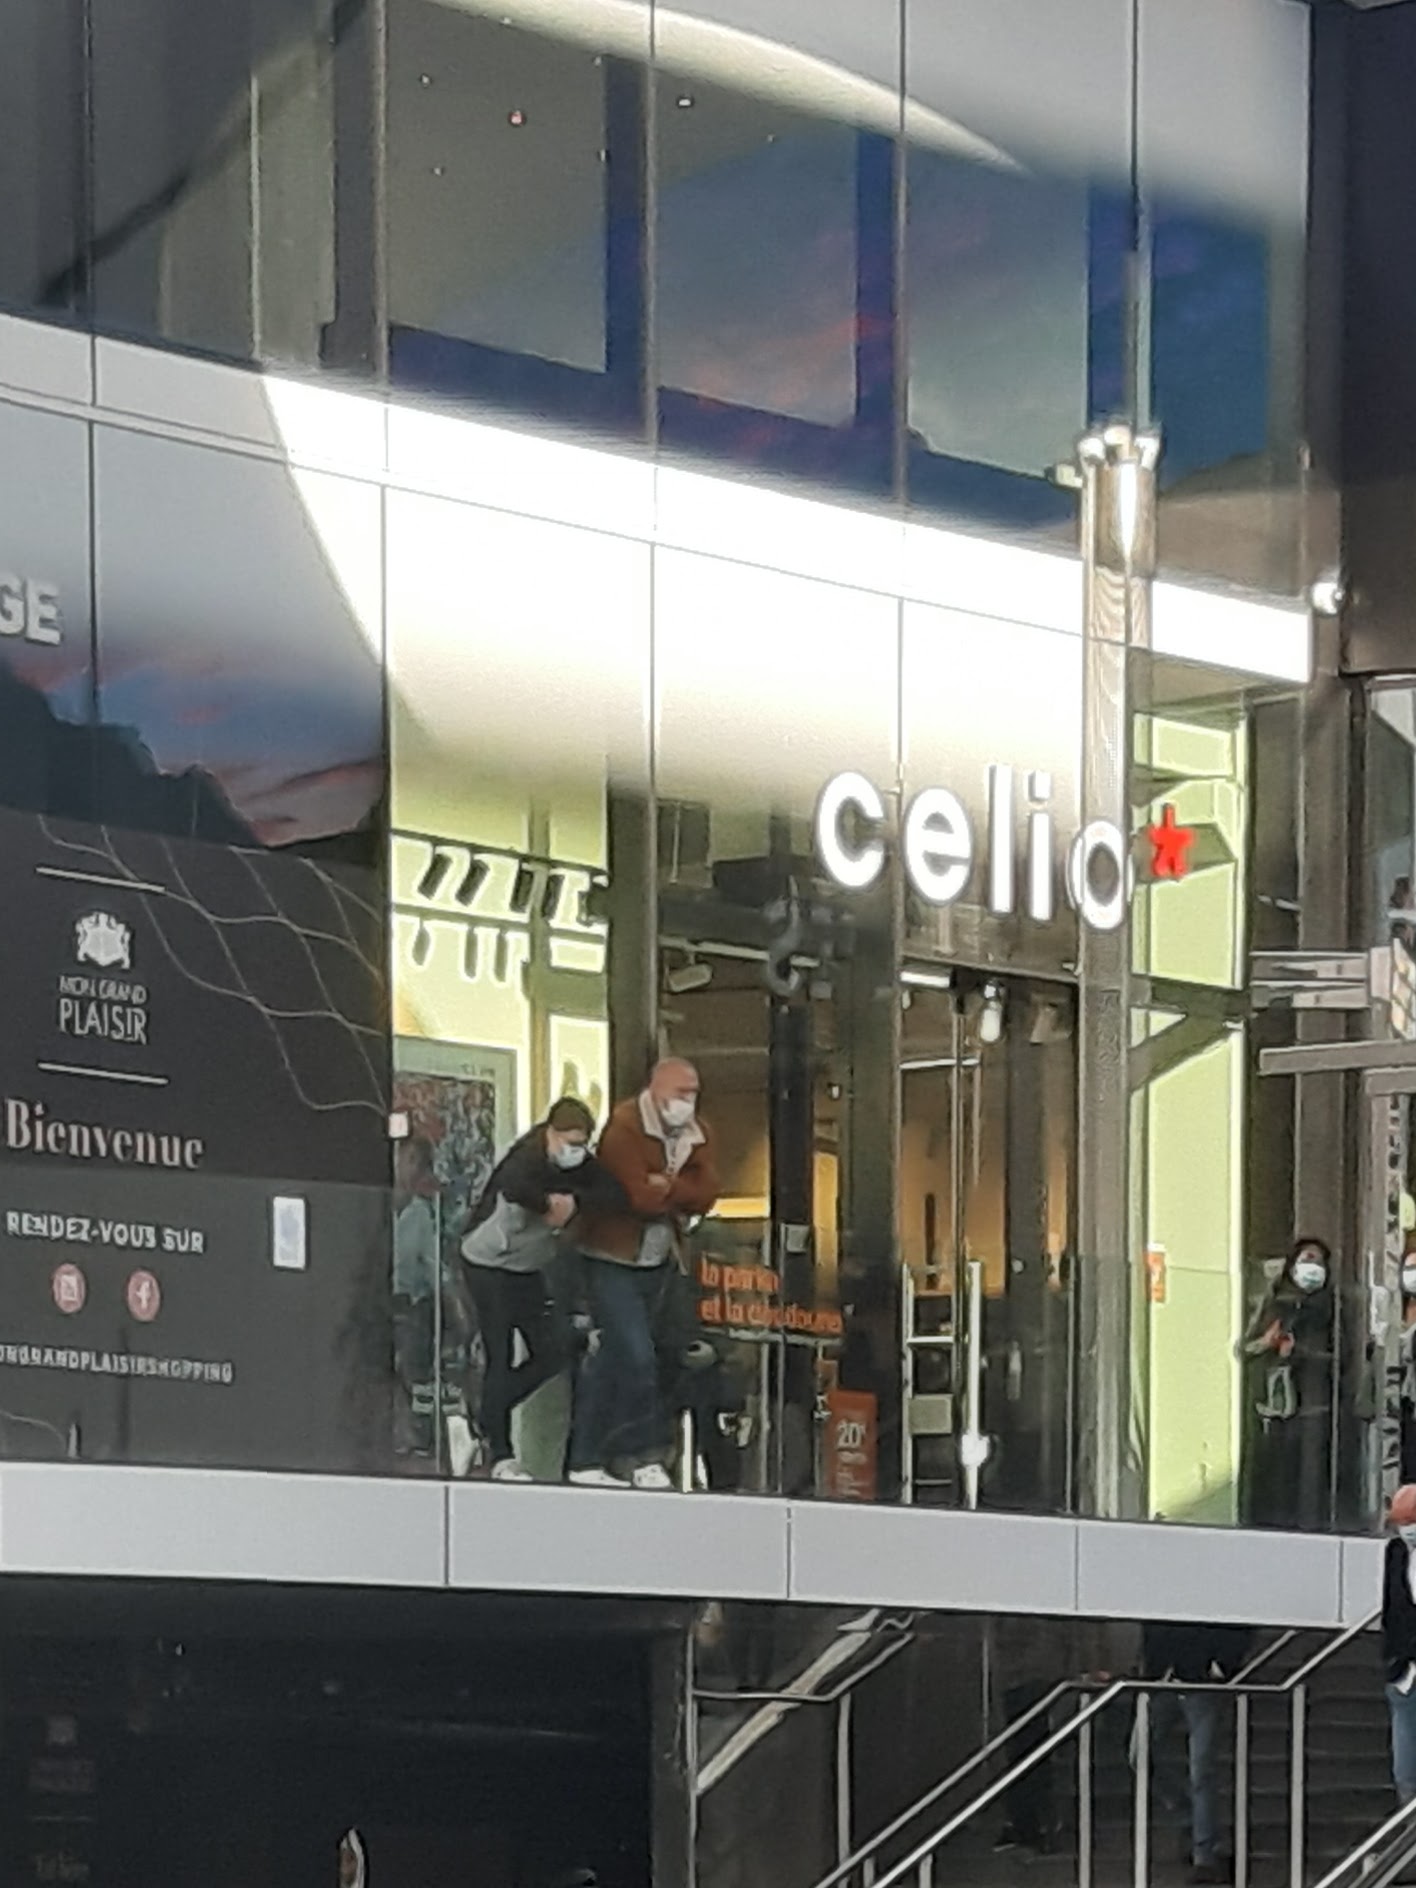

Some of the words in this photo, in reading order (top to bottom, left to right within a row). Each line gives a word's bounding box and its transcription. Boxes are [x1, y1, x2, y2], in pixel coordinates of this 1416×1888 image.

[817, 763, 1129, 930] celio
[59, 997, 147, 1045] PLAISIR
[5, 1098, 204, 1169] Bienvenue
[6, 1210, 156, 1249] RENDEZ-VOUS
[162, 1225, 205, 1254] SUR
